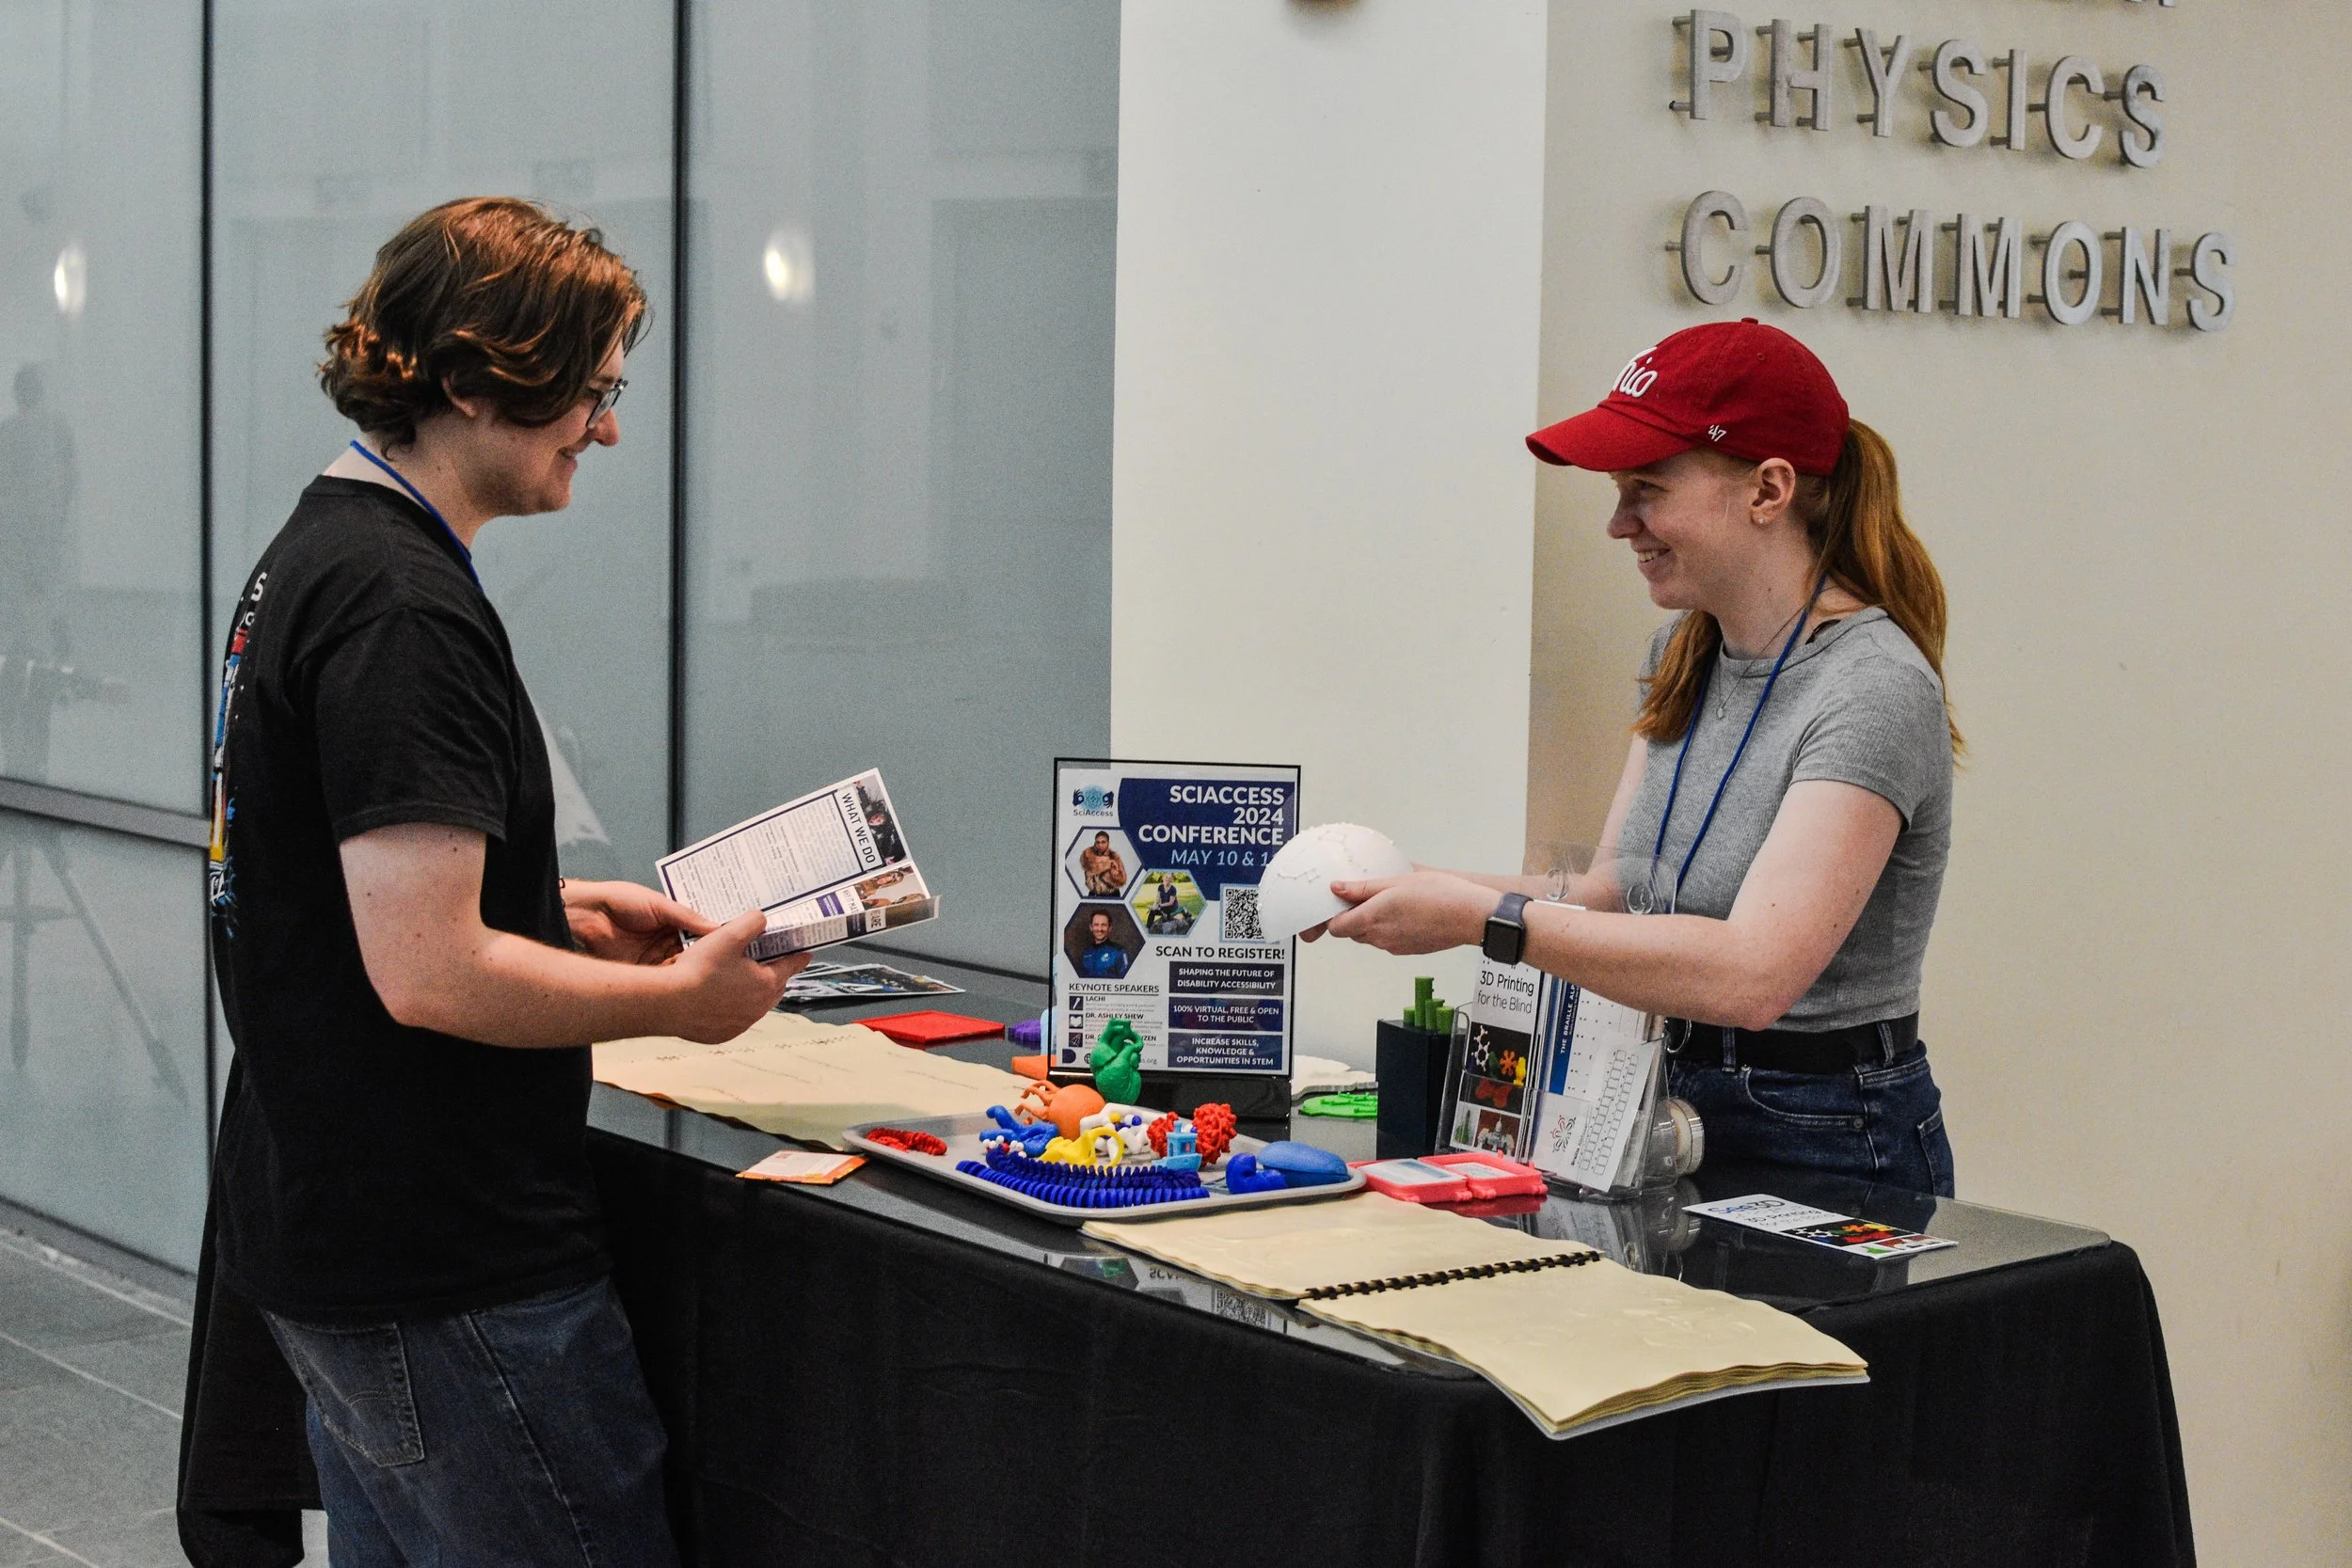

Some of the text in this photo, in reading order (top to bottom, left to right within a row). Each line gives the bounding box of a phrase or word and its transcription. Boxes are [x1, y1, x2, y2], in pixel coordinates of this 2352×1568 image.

[1689, 8, 2165, 168] PHYSICS
[1679, 189, 2236, 332] COMMONS
[1612, 345, 1659, 398] hio
[1168, 784, 1285, 806] SCIACCESS
[1073, 808, 1114, 817] SciAccess
[1232, 806, 1285, 826] 2024
[841, 792, 876, 863] WHAT WE DO
[1137, 824, 1285, 846] CONFERENCE
[1170, 849, 1270, 867] MAY 10 & 1
[1155, 945, 1285, 959] SCAN TO REGISTER!
[1178, 968, 1214, 976] SHAPING
[1215, 968, 1231, 976] THE
[1232, 969, 1263, 977] FUTURE
[1069, 983, 1160, 993] KEYNOTE SPEAKERS
[1177, 979, 1276, 990] DISABILITY ACCESSIBILITY
[1479, 970, 1534, 996] 3D Printing
[1173, 1005, 1193, 1013] 100%
[1194, 1006, 1230, 1014] VIRTUAL,
[1477, 990, 1534, 1014] for the Blind
[1563, 1003, 1574, 1036] BRAILLE
[1191, 1037, 1259, 1047] INCREASE SKILLS,
[1195, 1047, 1248, 1055] KNOWLEDGE
[1176, 1056, 1240, 1065] OPPORTUNITIES
[1251, 1057, 1274, 1066] STEM
